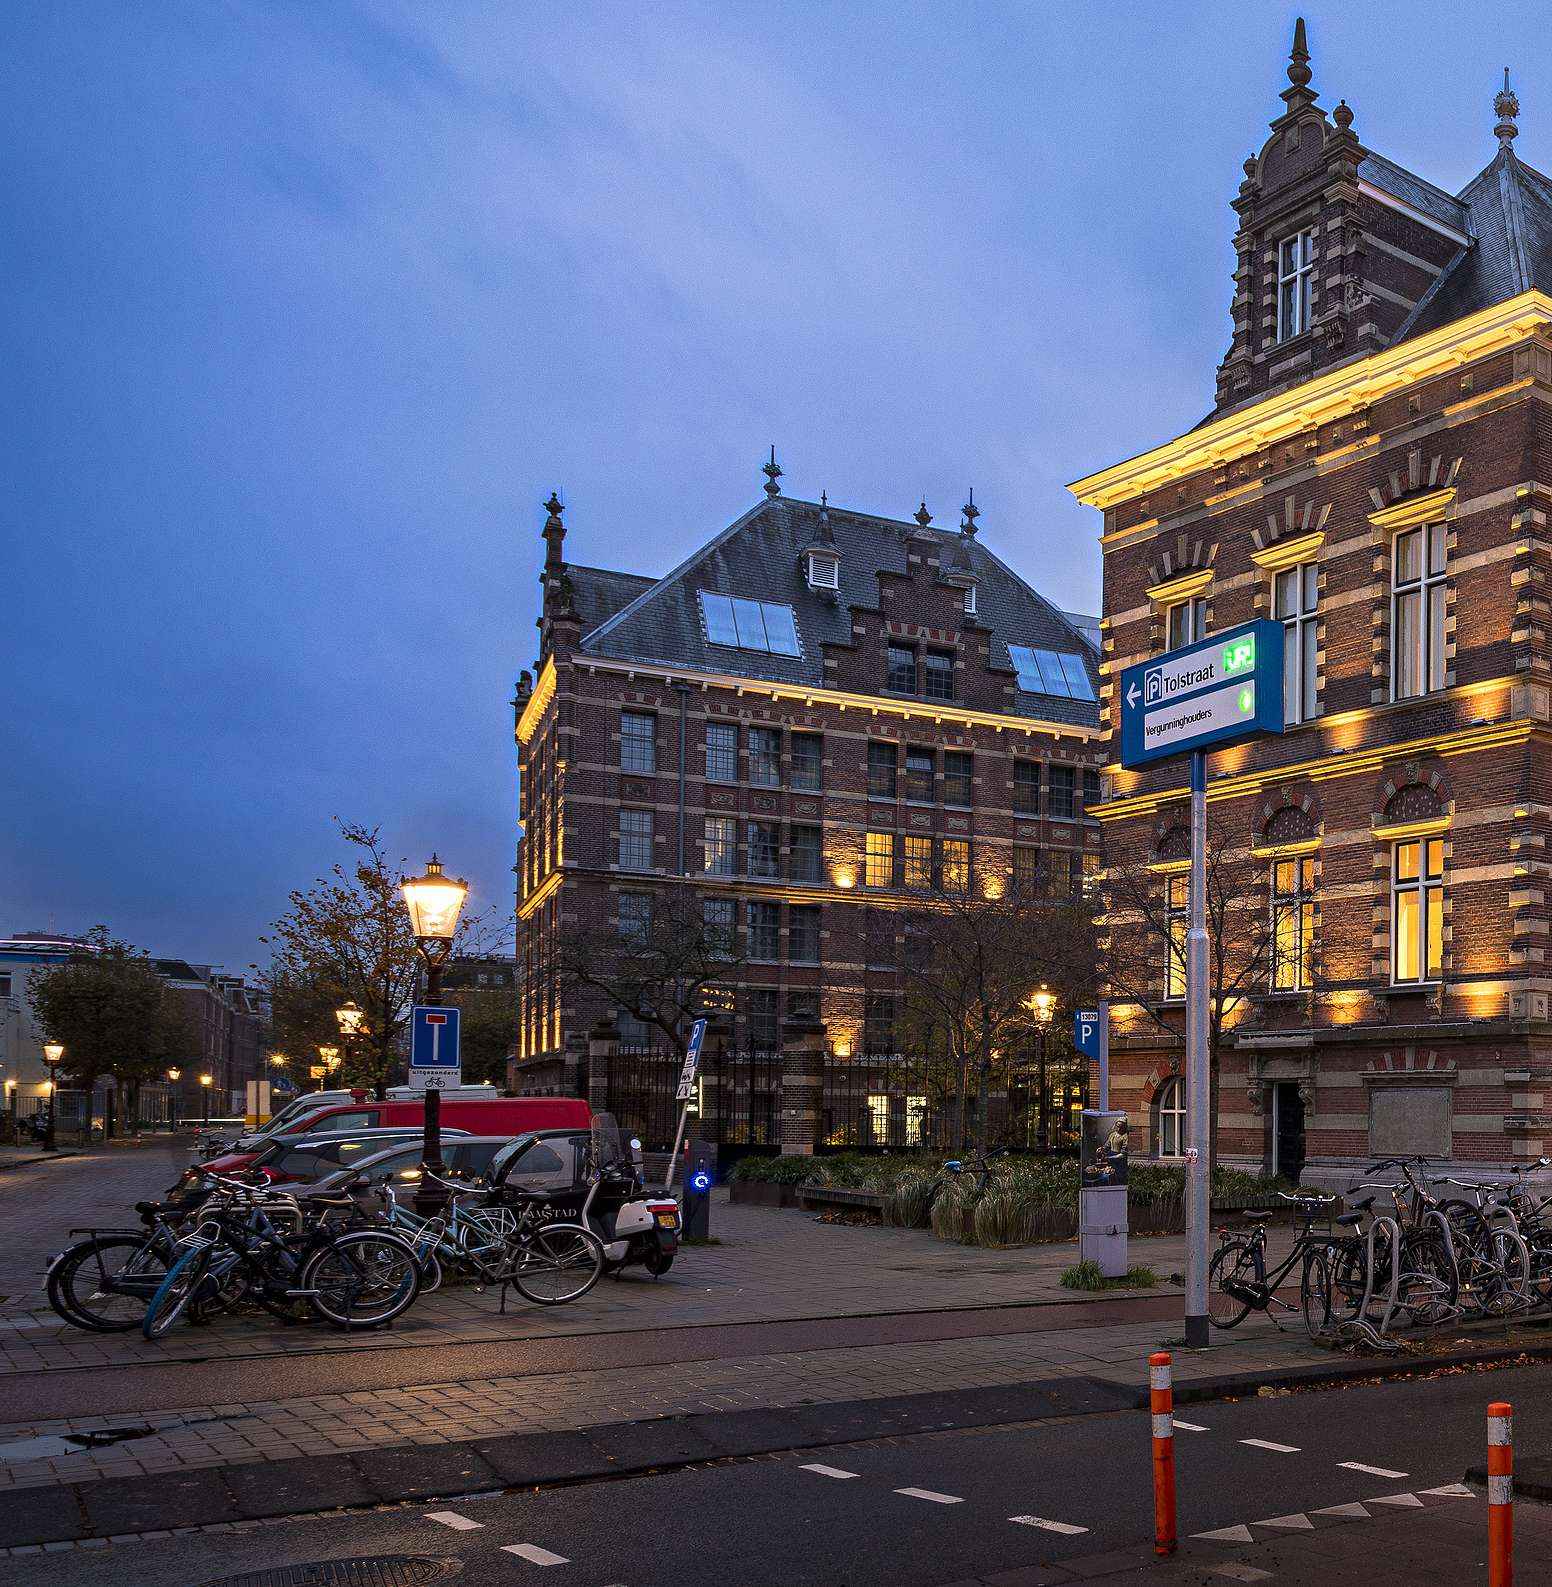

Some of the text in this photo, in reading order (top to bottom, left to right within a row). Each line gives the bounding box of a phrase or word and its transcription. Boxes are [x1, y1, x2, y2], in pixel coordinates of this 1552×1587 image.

[1163, 663, 1215, 693] Tolstraat
[1146, 709, 1213, 736] Vergunninghouders
[1081, 1024, 1092, 1044] P
